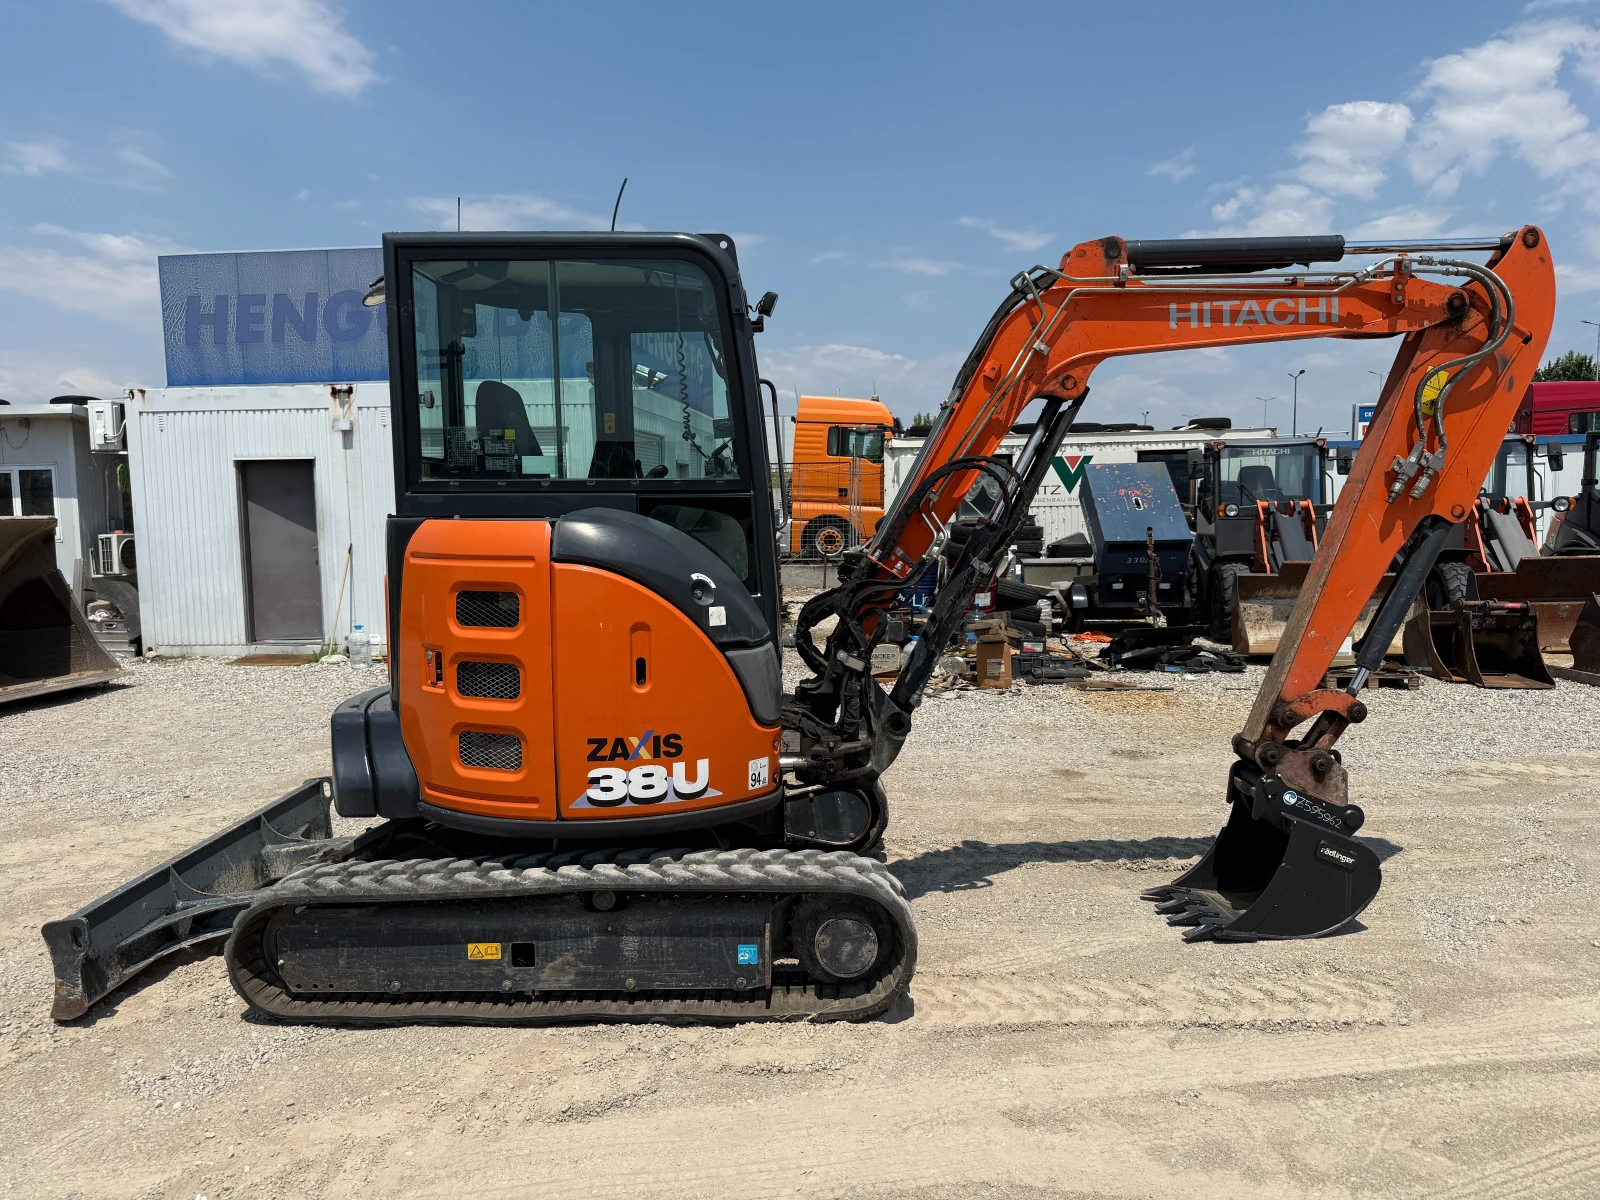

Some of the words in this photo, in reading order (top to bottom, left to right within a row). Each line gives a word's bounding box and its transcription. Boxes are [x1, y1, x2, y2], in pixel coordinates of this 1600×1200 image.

[1169, 296, 1339, 330] HITACHI
[1252, 448, 1291, 456] HITACHI
[587, 730, 683, 762] ZAXIS
[587, 758, 709, 807] 38U
[750, 771, 761, 788] 94
[1320, 847, 1356, 864] rädlinger
